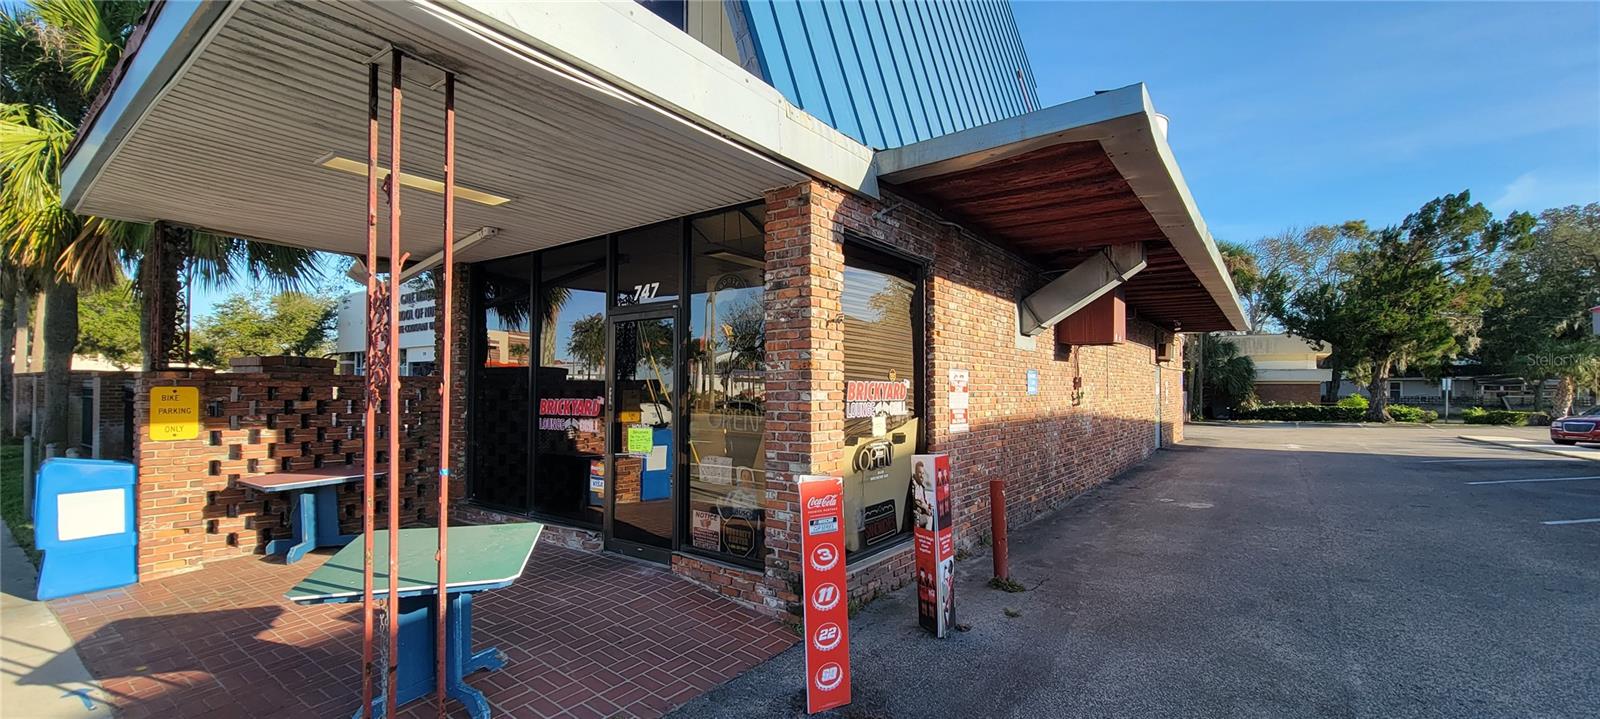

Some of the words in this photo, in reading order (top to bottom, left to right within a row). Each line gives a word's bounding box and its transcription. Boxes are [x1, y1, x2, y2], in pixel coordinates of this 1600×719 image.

[634, 282, 660, 301] 747
[161, 394, 181, 402] BIKE
[847, 380, 907, 402] BRICKYARD
[158, 407, 192, 415] PARKING
[540, 398, 601, 417] BRICKYARD
[847, 402, 876, 419] LOUNGE
[164, 425, 185, 433] ONLY
[539, 417, 565, 431] LOUNGE
[859, 443, 894, 472] OPEN
[808, 495, 838, 509] Coca-Cola
[695, 511, 718, 522] NOTICE
[817, 548, 833, 561] 3
[818, 586, 834, 603] 11
[818, 626, 837, 642] 22
